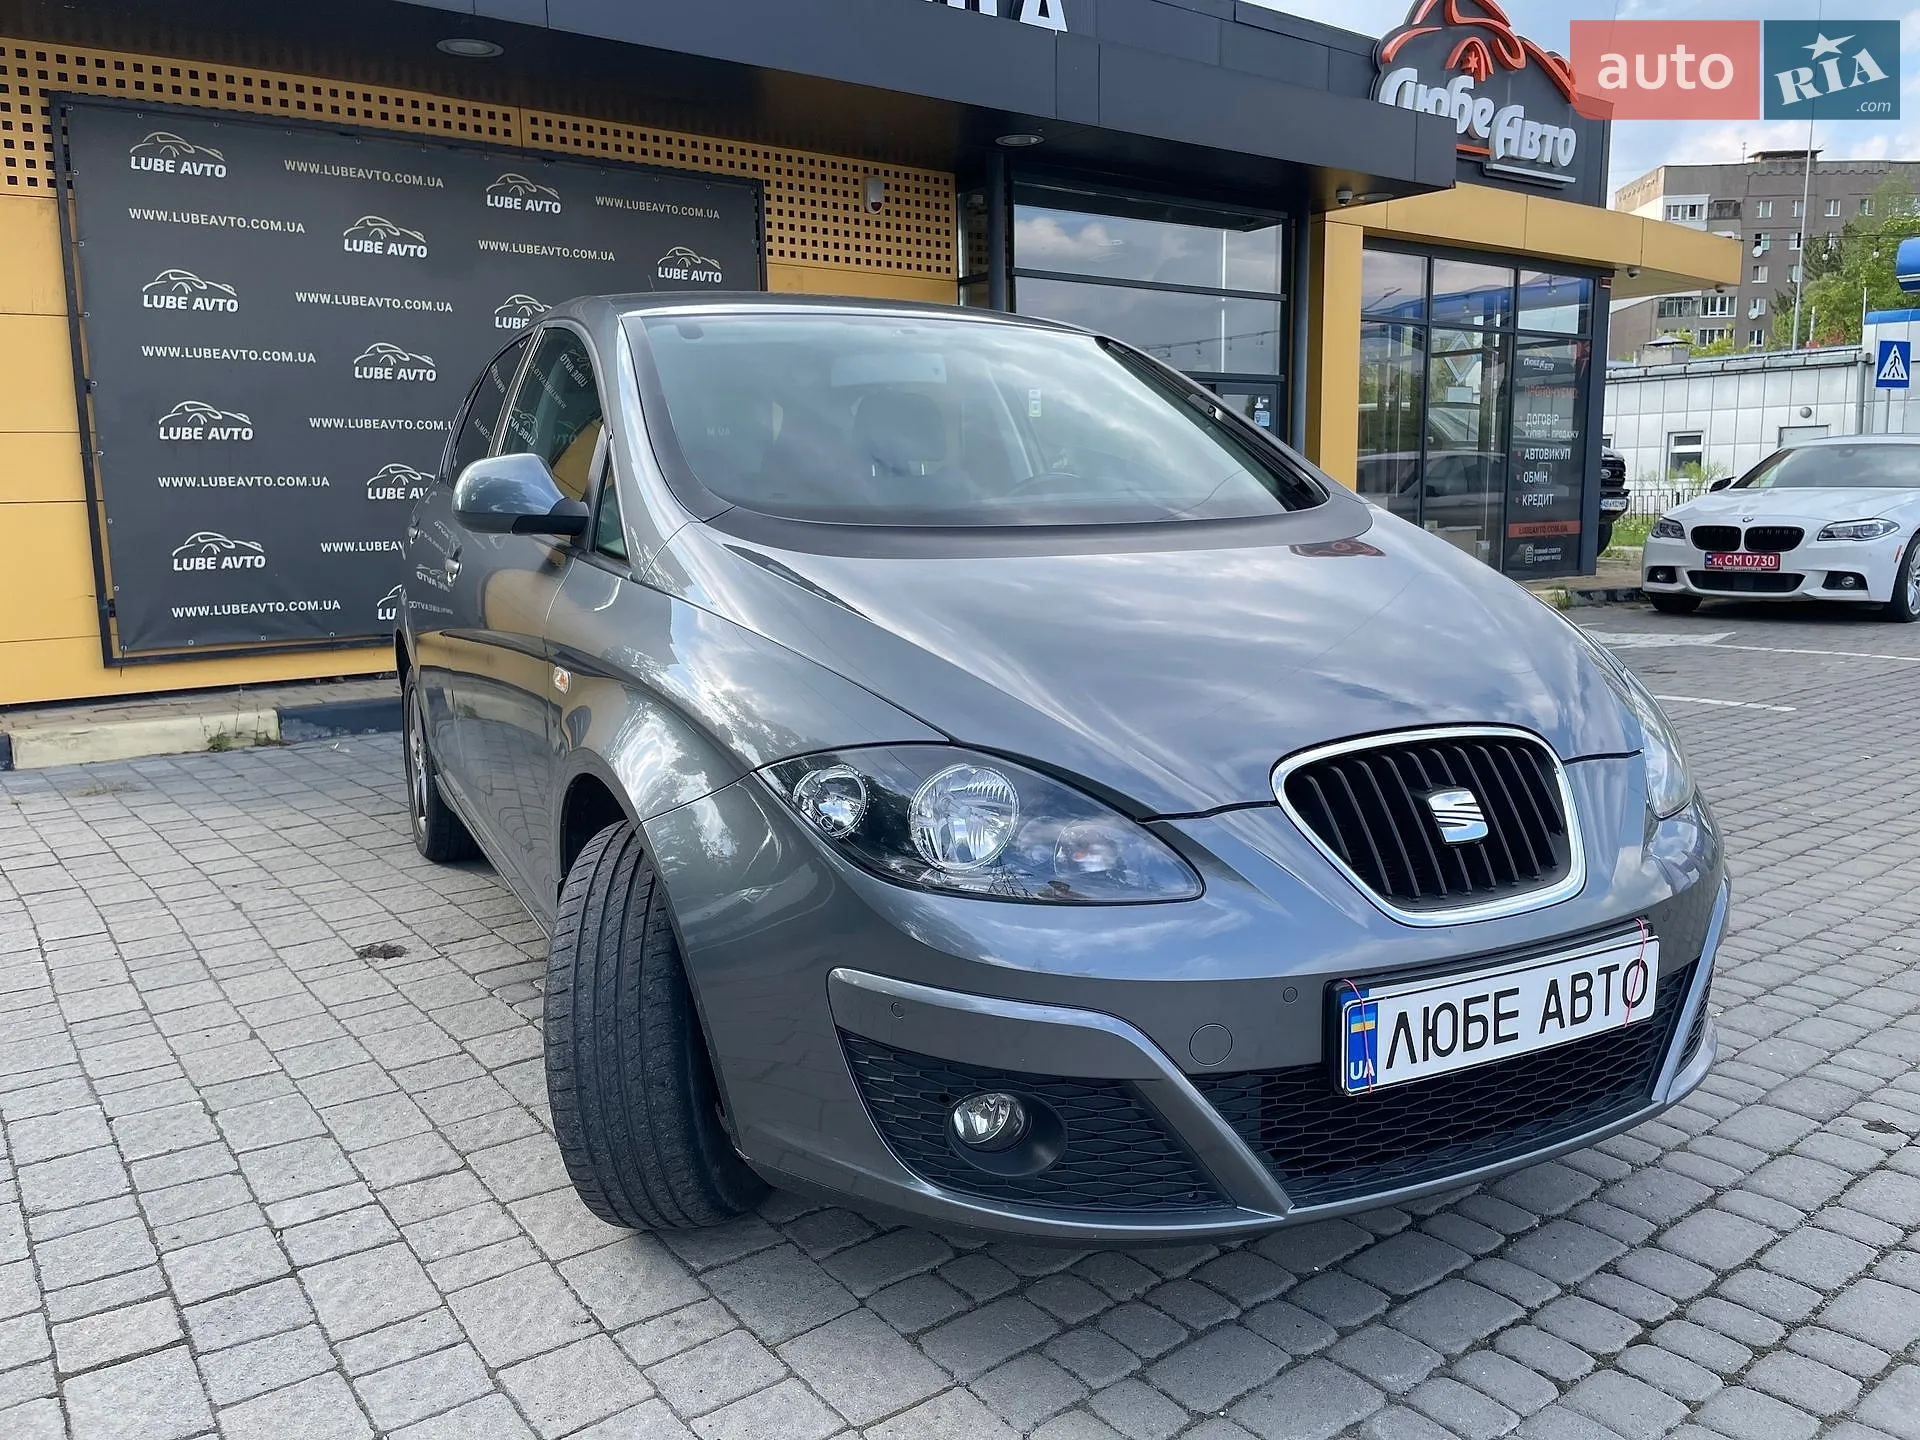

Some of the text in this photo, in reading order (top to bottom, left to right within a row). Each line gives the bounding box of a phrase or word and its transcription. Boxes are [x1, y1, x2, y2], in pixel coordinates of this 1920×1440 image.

[130, 156, 227, 178] LUBE AVTO
[285, 159, 444, 189] WWW.LUBEAVTO.COM.UA
[487, 194, 562, 214] LUBE AVTO
[595, 195, 720, 220] WWW.LUBEAVTO.COM.UA
[129, 208, 305, 234] WWW.LUBEAVTO.COM.UA
[344, 238, 428, 258] LUBE AVTO
[478, 239, 615, 262] WWW.LUBEAVTO.COM.UA
[658, 266, 722, 283] LUBE AVTO
[143, 294, 239, 313] LUBE AVTO
[295, 292, 453, 313] WWW.LUBEAVTO.COM.UA
[141, 345, 316, 364] WWW.LUBEAVTO.COM.UA
[354, 366, 437, 382] LUBE AVTO
[1525, 412, 1560, 428] ДОГОВІР
[159, 427, 254, 441] LUBE AVTO
[1524, 448, 1571, 460] АВТОВИКУП
[158, 476, 330, 488] WWW.LUBEAVTO.COM.UA
[1523, 471, 1548, 483] ОБМІН
[367, 487, 405, 500] LUBE
[1522, 493, 1554, 508] КРЕДИТ
[173, 555, 266, 571] LUBE AVTO
[1745, 555, 1776, 567] 0730
[172, 599, 341, 618] WWW.LUBEAVTO.COM.UA
[1386, 958, 1649, 1070] ЛЮБЕ АВТО
[1349, 1057, 1376, 1080] UA
